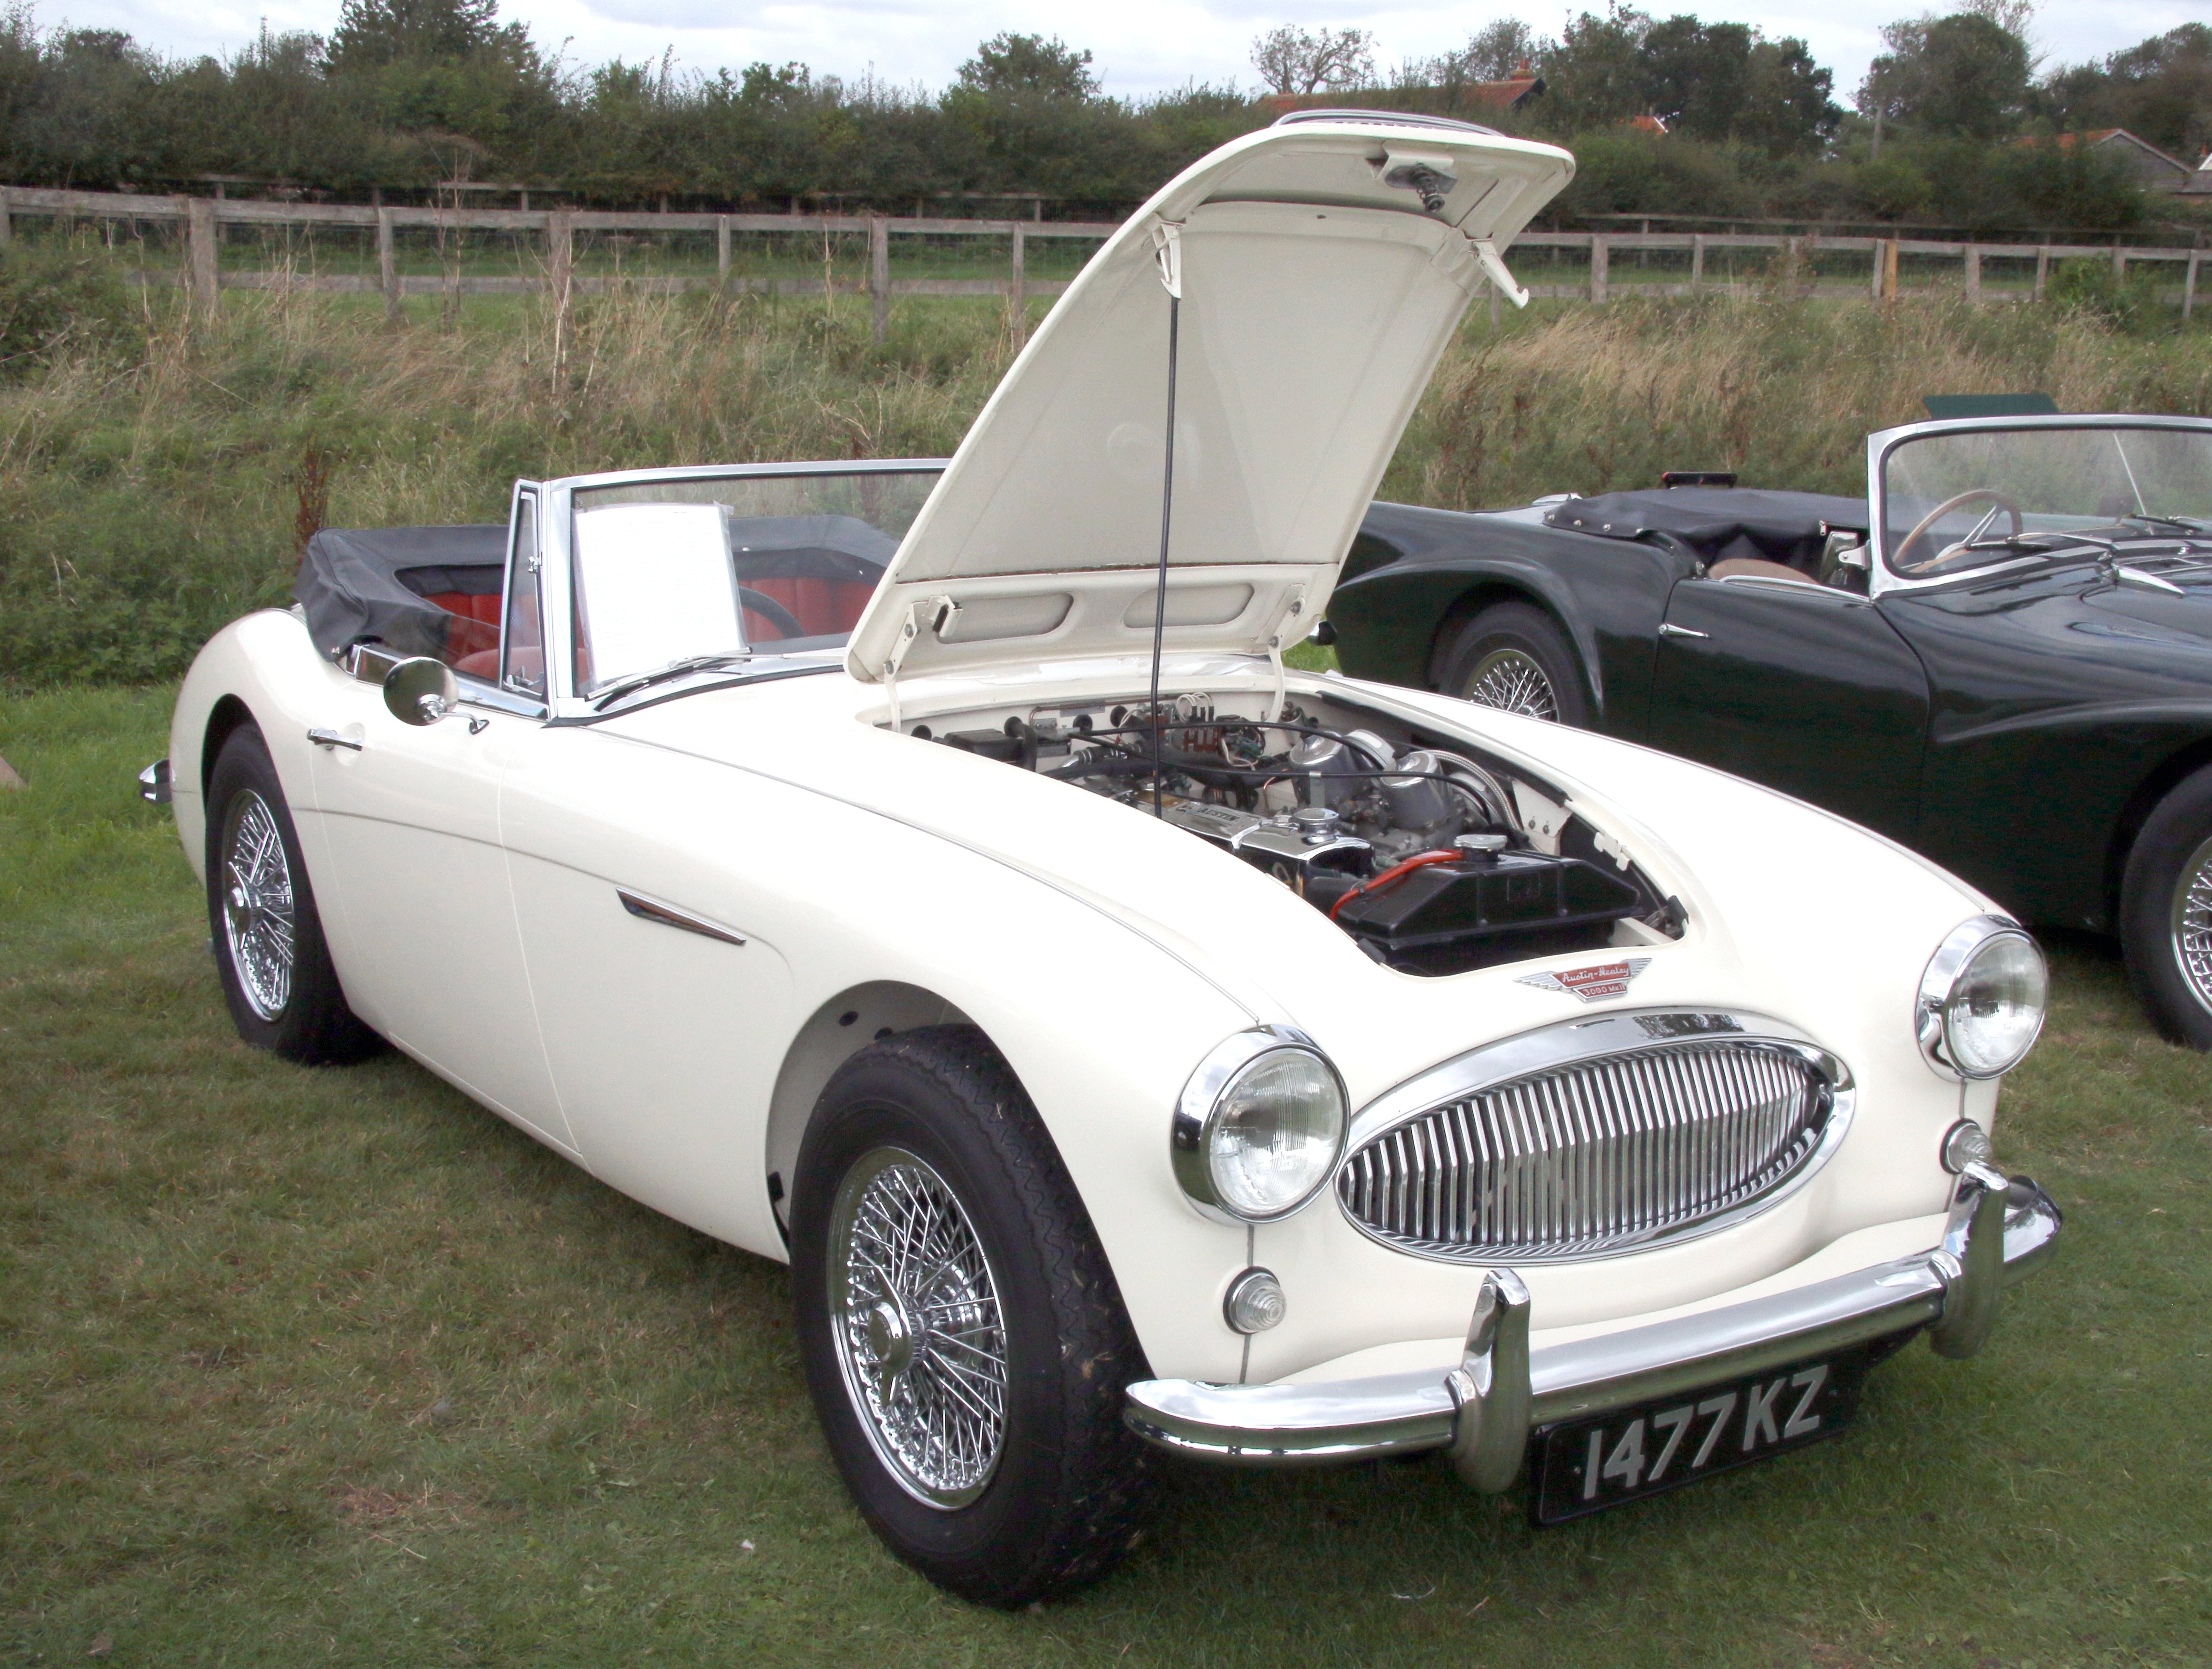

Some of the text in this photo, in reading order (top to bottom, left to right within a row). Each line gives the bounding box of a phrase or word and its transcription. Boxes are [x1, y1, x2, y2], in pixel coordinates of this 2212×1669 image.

[1562, 966, 1629, 983] Austin-Healey
[1583, 986, 1608, 996] 3000
[1584, 1364, 1828, 1500] 1477 KZ
